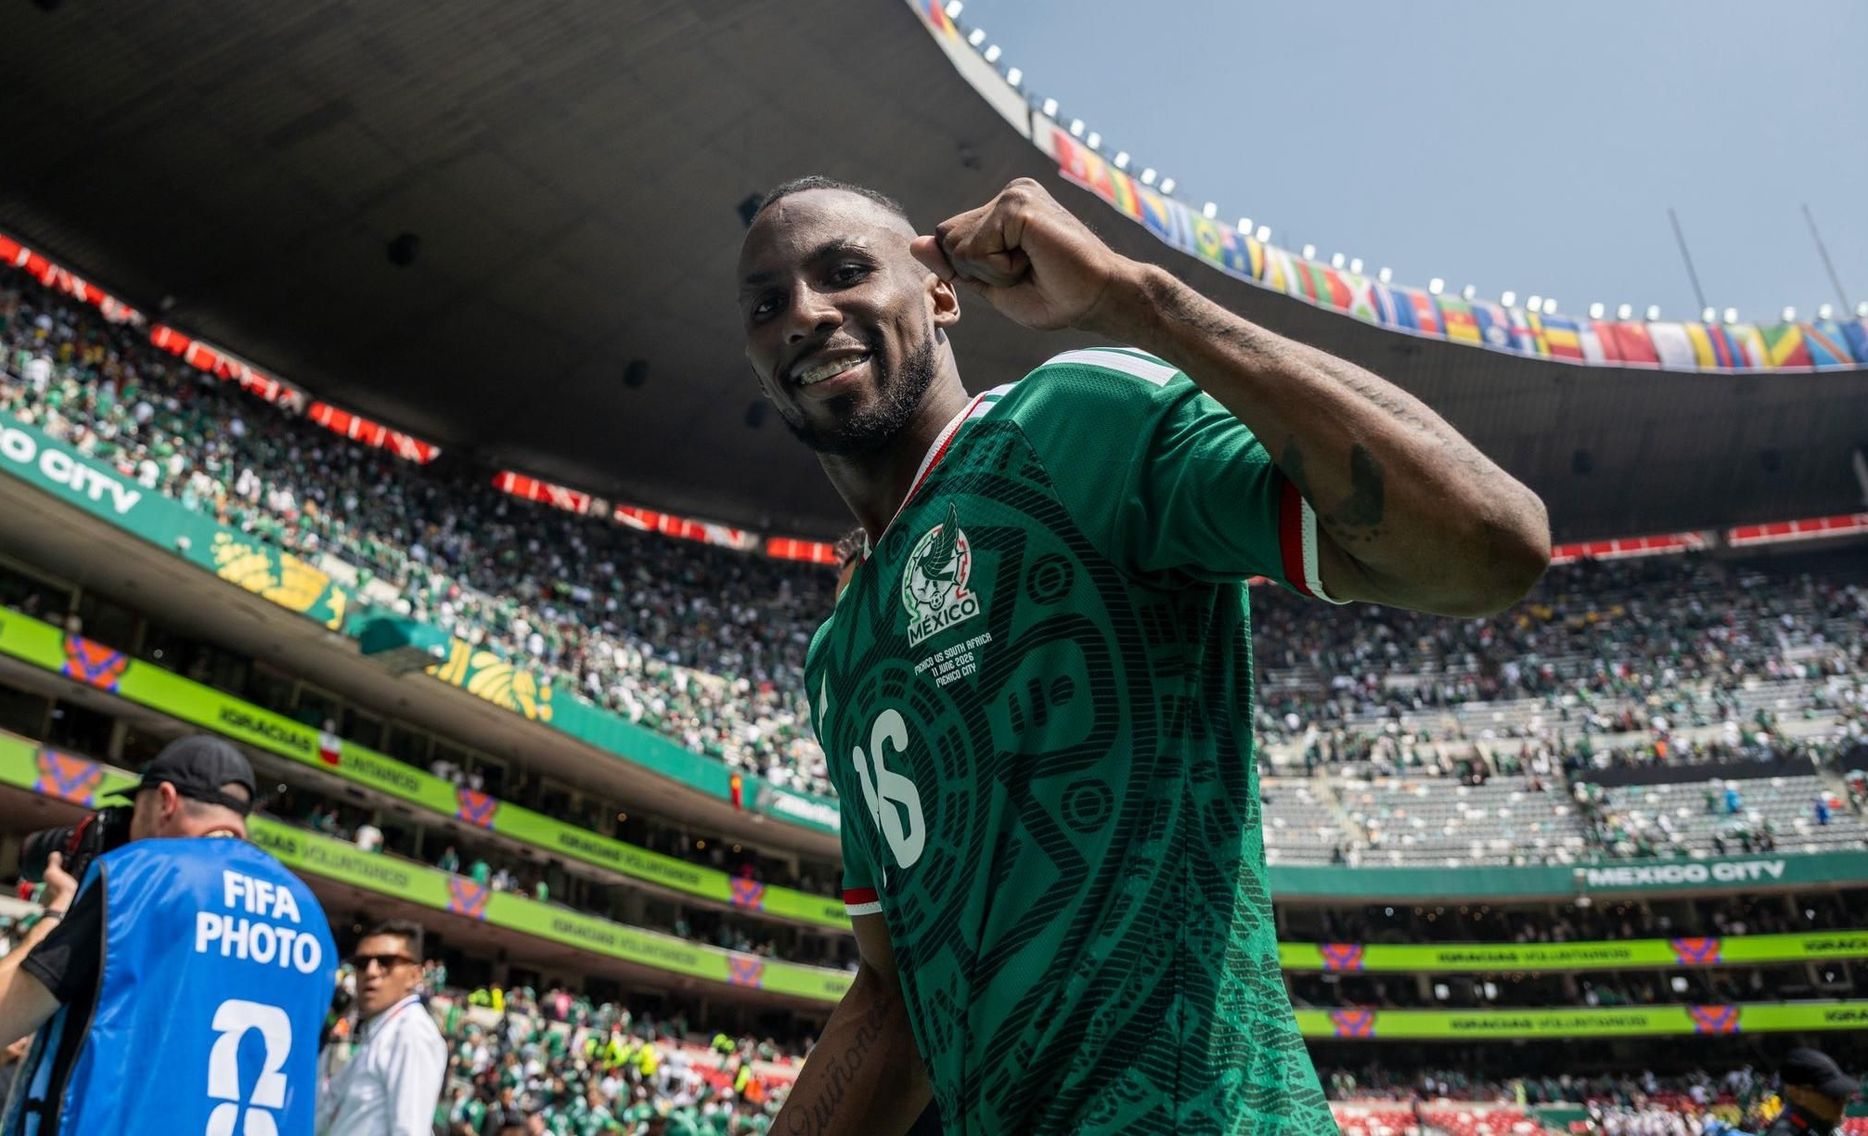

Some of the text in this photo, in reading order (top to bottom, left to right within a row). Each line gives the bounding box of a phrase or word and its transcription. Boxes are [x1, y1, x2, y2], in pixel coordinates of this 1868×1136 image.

[0, 422, 142, 514] O CITY
[909, 598, 976, 645] MÉXICO
[914, 656, 934, 676] MEXICO
[945, 643, 966, 659] SOUTH
[966, 632, 992, 650] AFRICA
[931, 652, 974, 677] 11 JUNE 2026
[935, 663, 976, 688] MEXICO CITY
[1587, 861, 1786, 886] MEXICO CITY
[223, 869, 301, 924] FIFA
[195, 911, 322, 974] PHOTO
